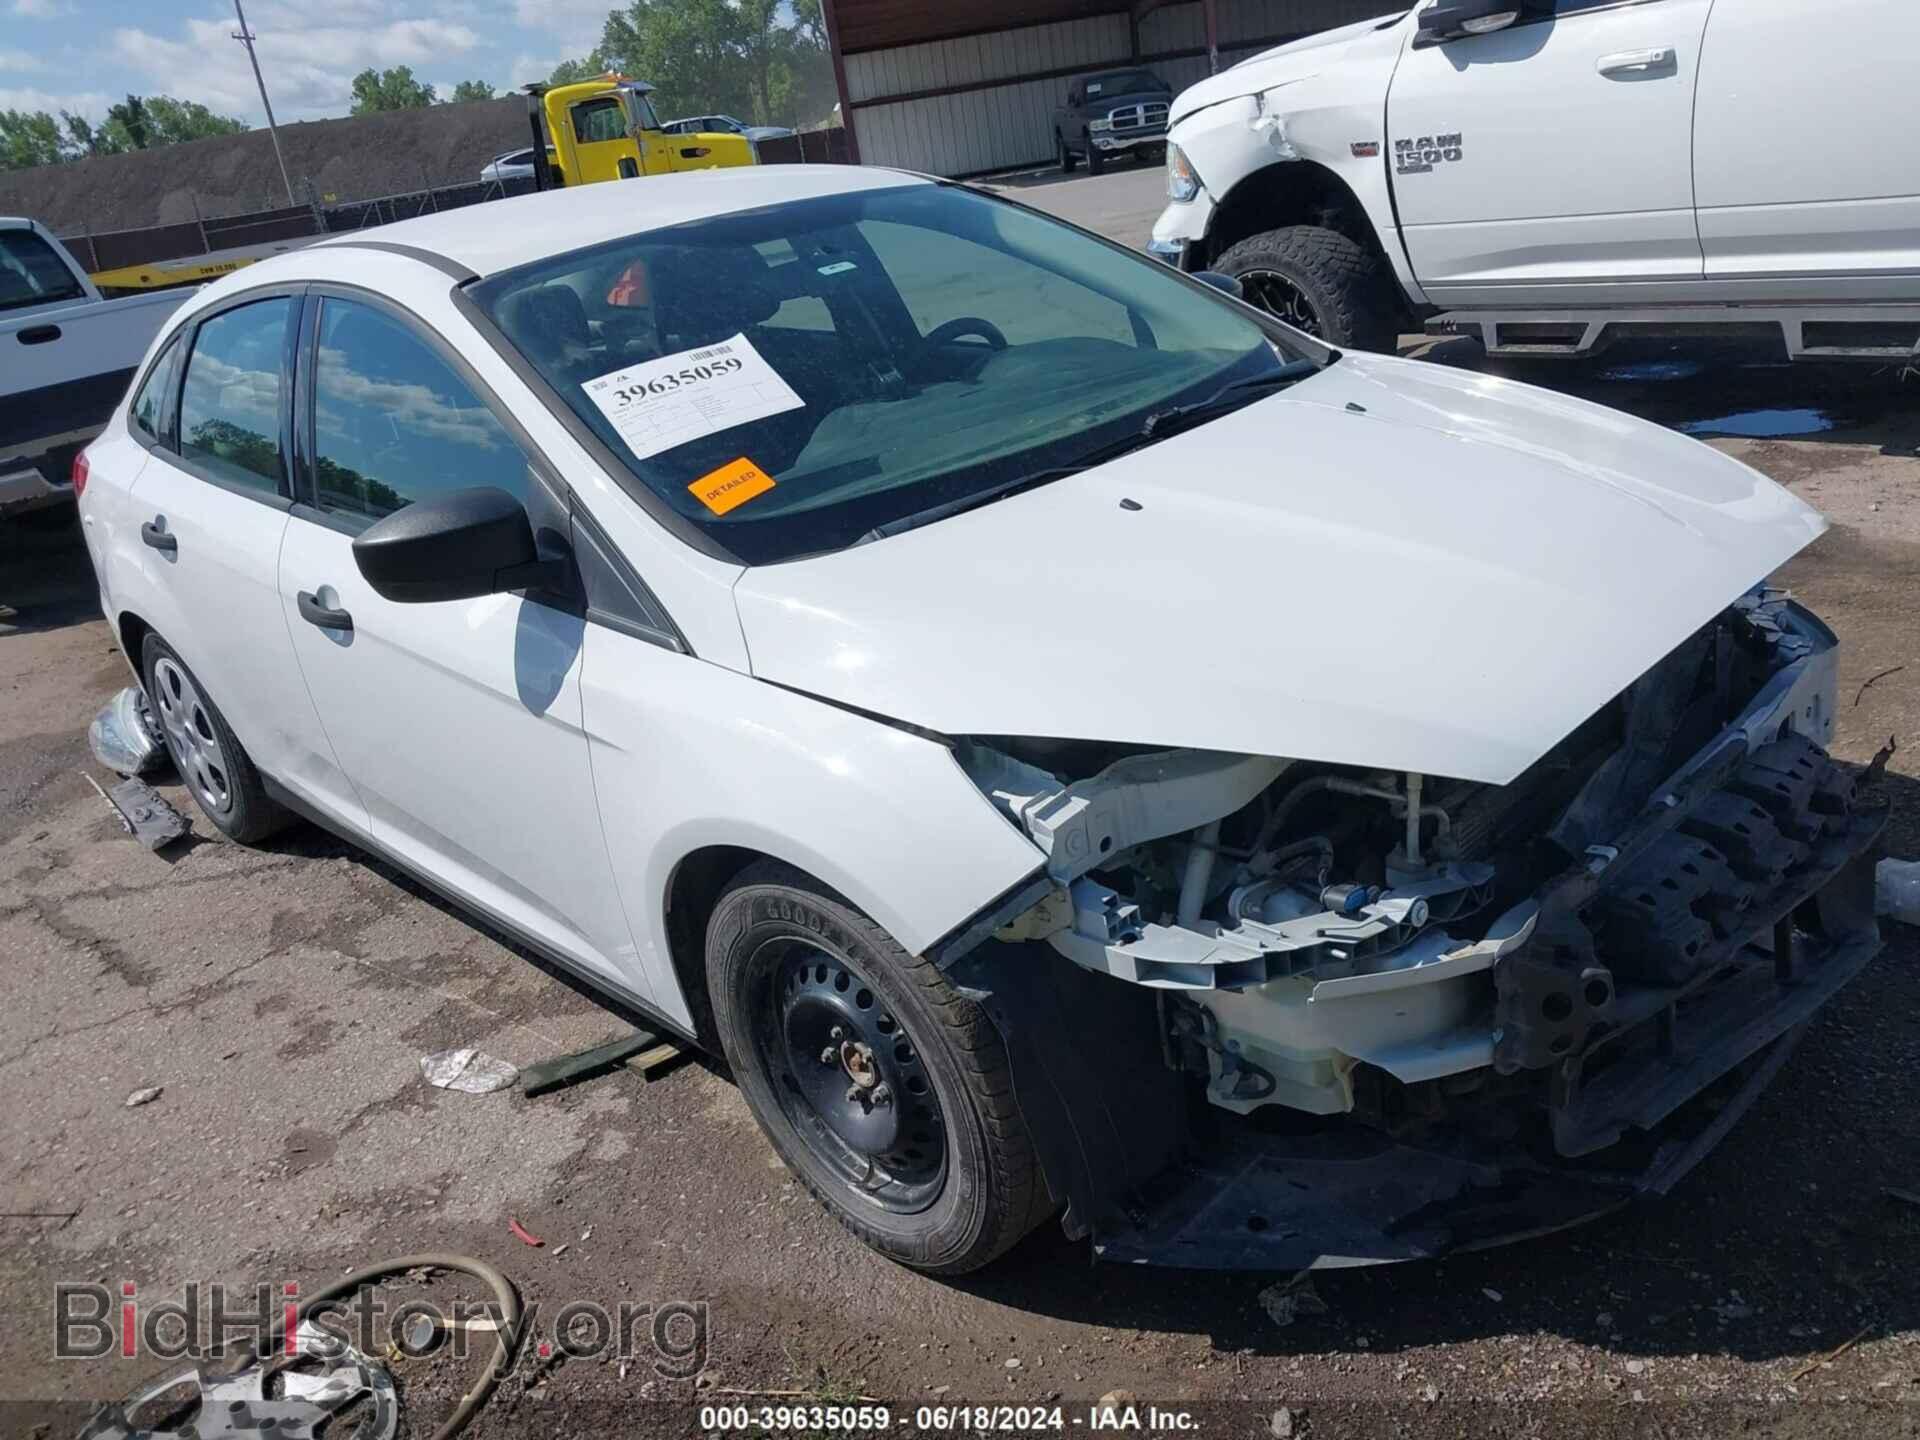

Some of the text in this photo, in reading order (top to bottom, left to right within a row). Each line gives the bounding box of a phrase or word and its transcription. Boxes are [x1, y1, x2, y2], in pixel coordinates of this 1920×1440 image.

[1395, 133, 1462, 152] RAM
[1396, 148, 1463, 166] 1500
[613, 357, 743, 406] 39635059
[706, 471, 756, 501] DETAILED
